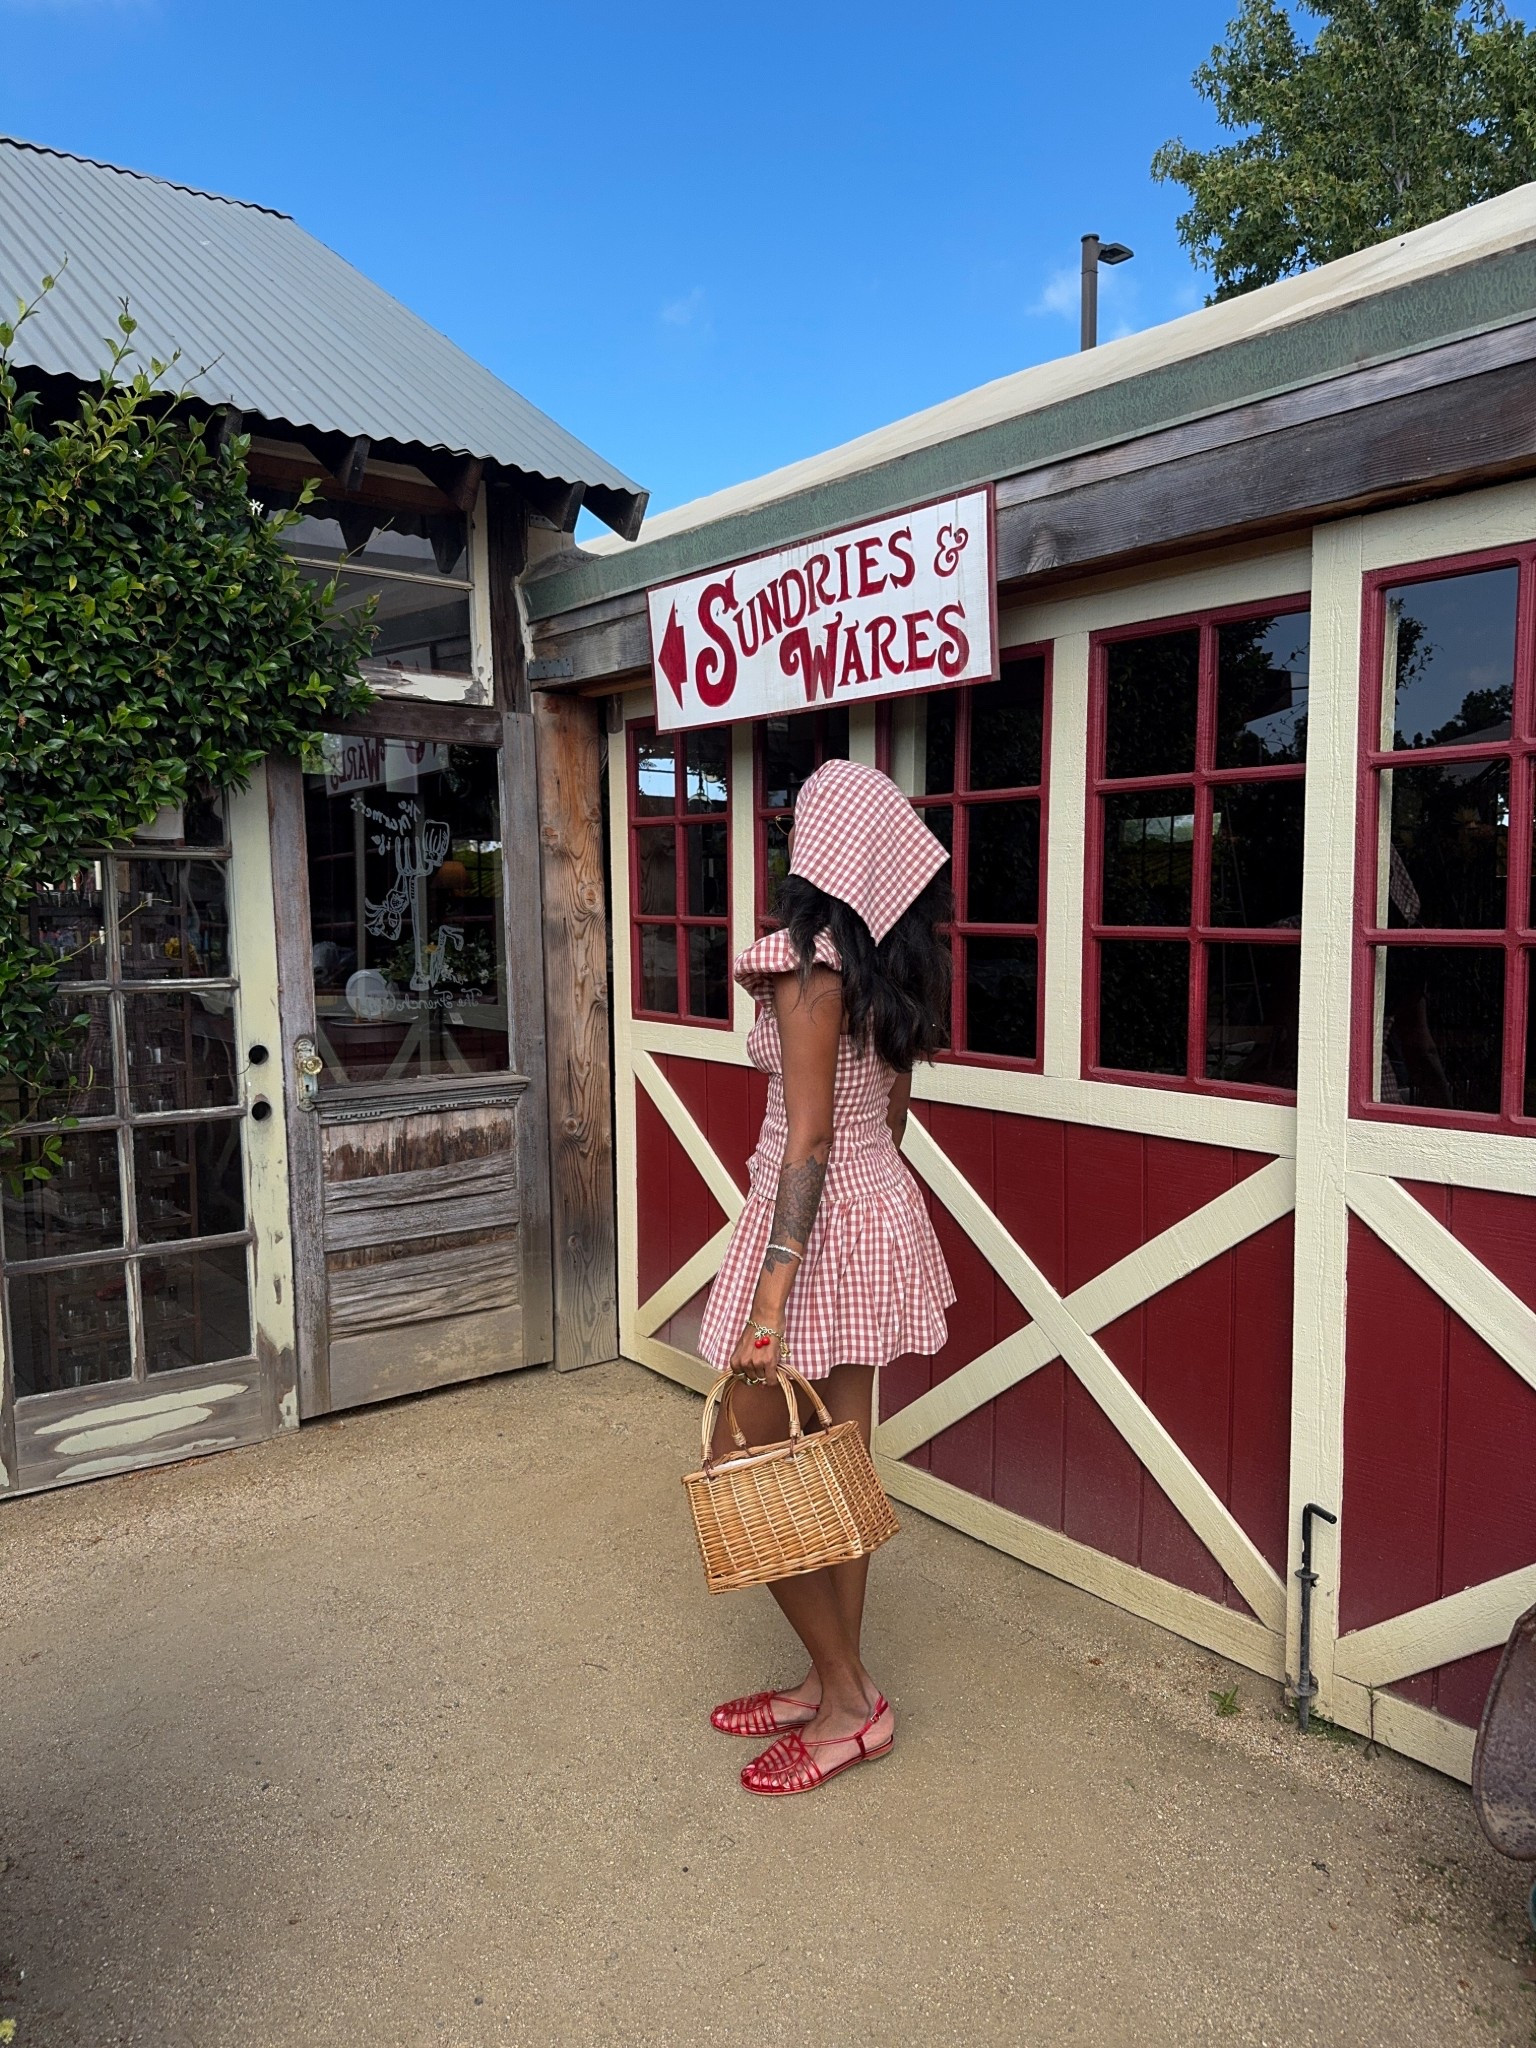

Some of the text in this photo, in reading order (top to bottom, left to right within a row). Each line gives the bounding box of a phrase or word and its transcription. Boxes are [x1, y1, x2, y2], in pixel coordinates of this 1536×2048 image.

[695, 523, 969, 708] SUNDRIES &
[779, 600, 970, 702] WARES
